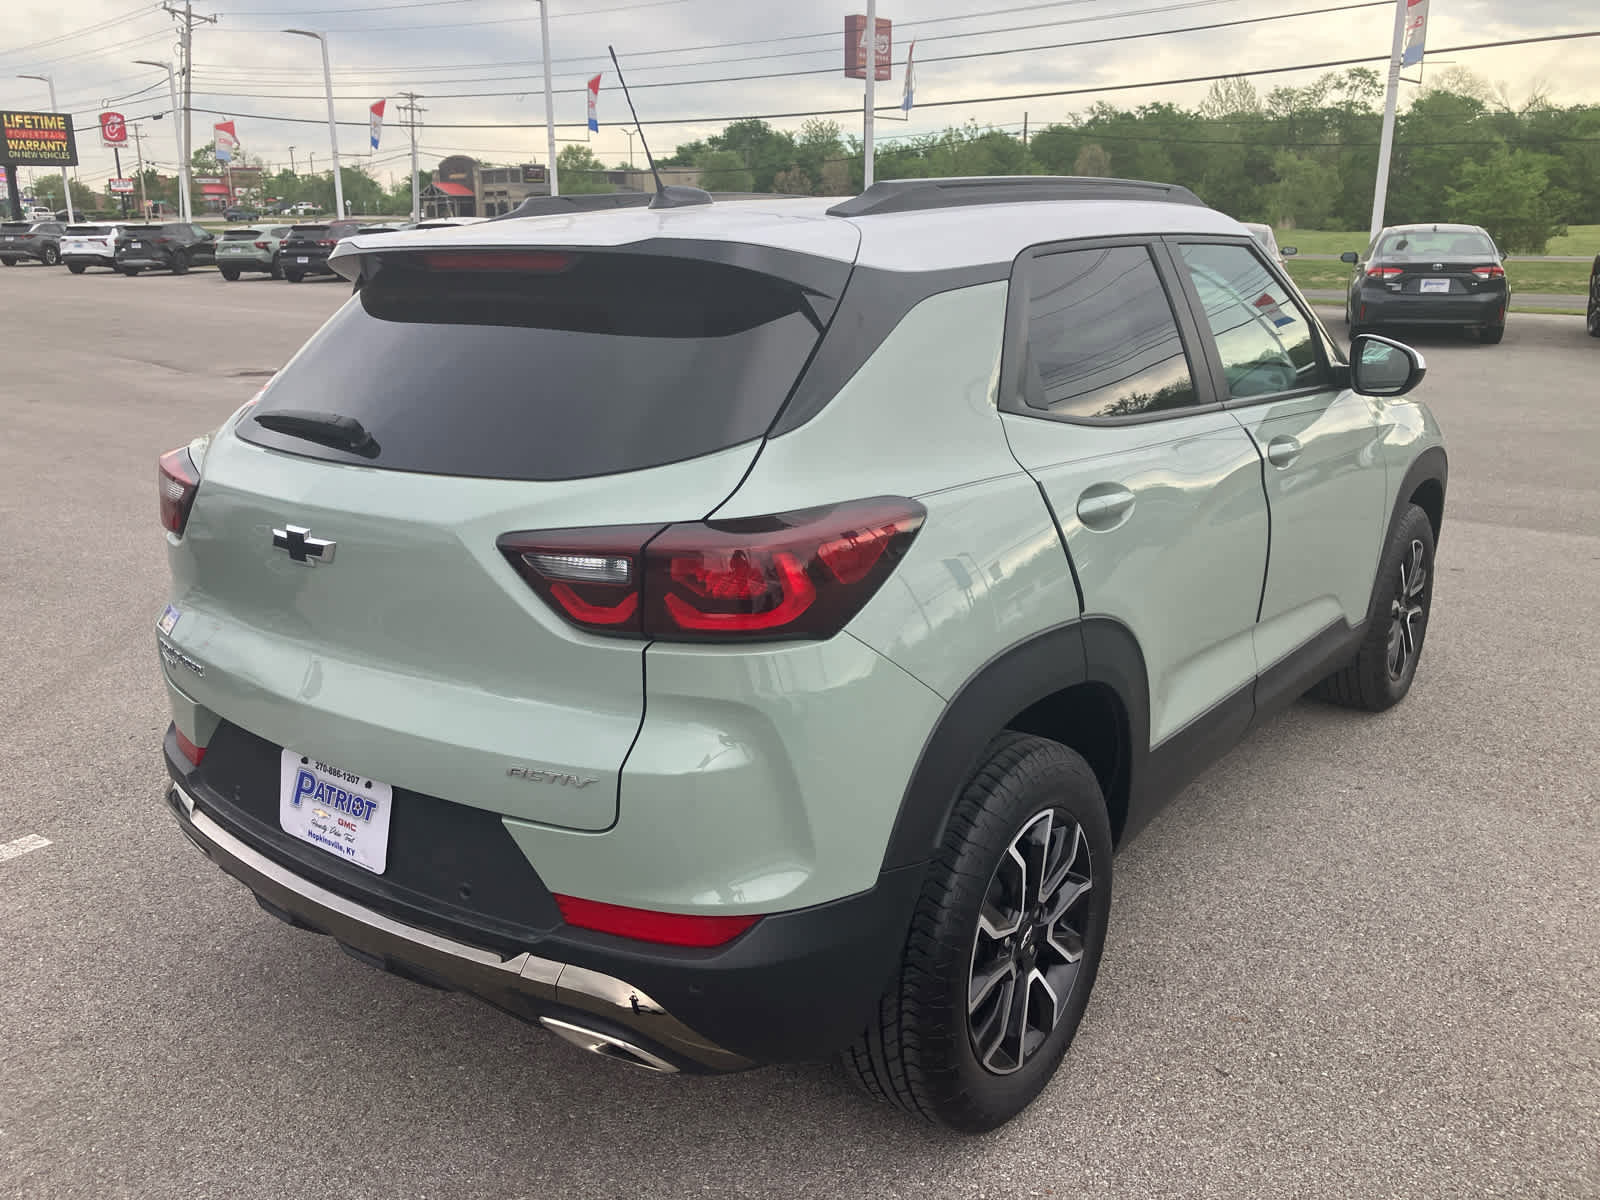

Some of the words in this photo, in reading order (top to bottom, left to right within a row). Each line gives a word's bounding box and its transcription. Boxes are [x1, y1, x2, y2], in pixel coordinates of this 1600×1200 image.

[3, 113, 66, 129] LIFETIME
[8, 140, 67, 151] WARRANTY
[8, 151, 20, 159] ON
[21, 151, 38, 159] NEW
[39, 151, 70, 159] VEHICLES
[315, 761, 360, 785] 270-886-1207
[293, 769, 377, 822] PATRIOT
[338, 818, 357, 832] GMC
[308, 830, 345, 854] Hopkinsville,
[346, 846, 356, 857] KY
